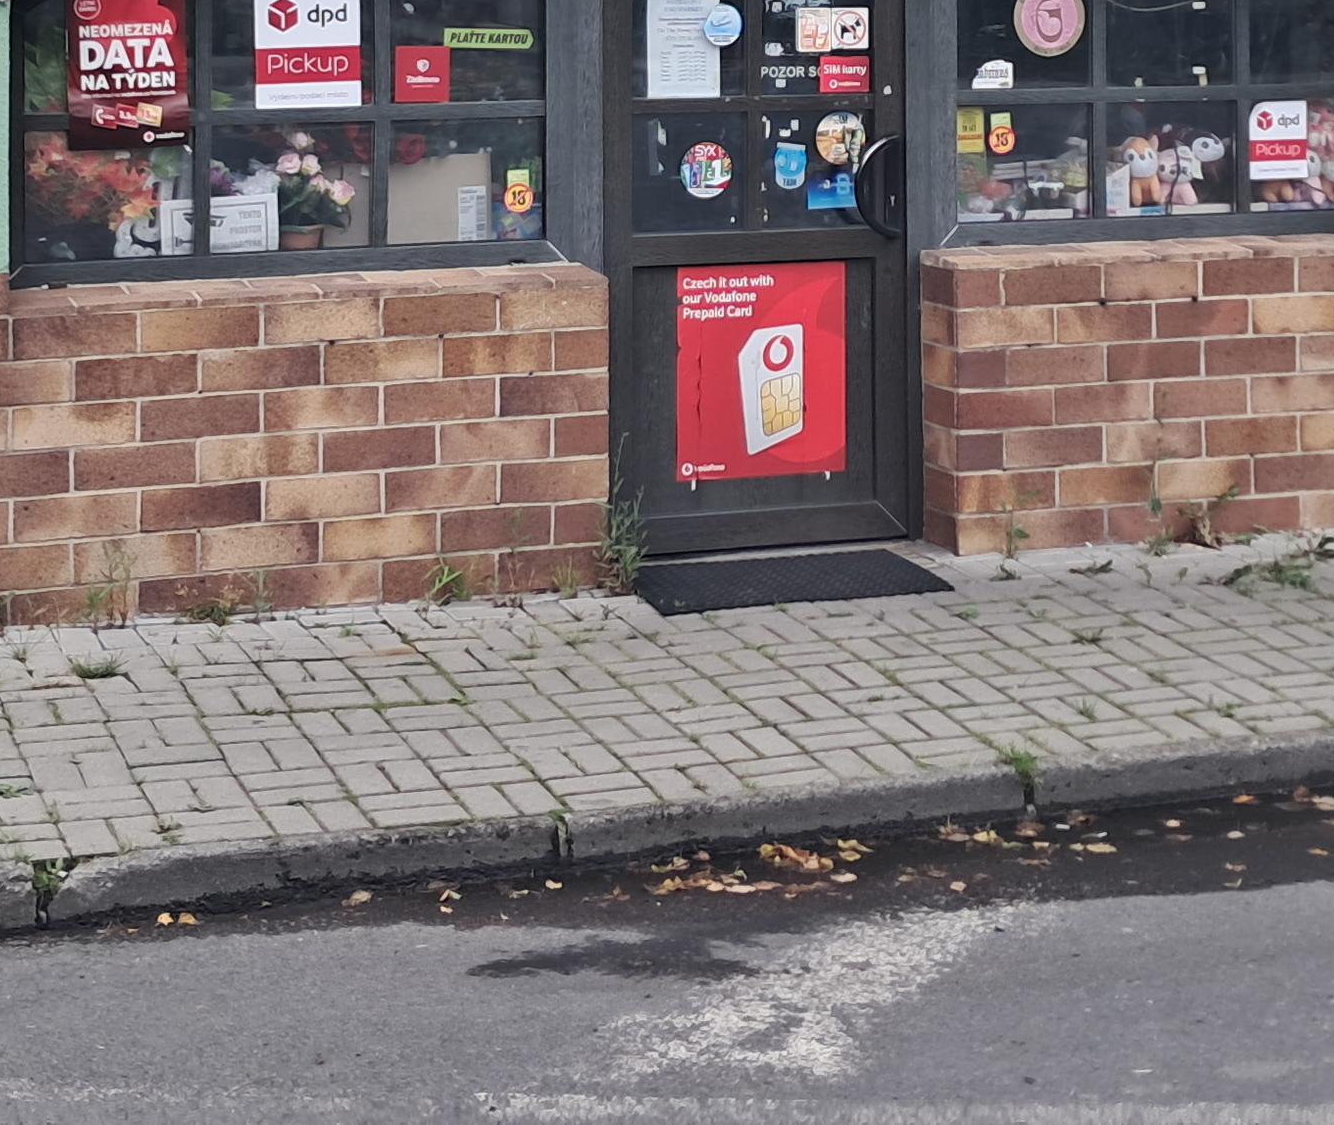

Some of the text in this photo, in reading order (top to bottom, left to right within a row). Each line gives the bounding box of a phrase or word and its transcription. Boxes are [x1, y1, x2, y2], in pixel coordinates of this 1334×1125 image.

[307, 2, 348, 28] dpd
[78, 19, 173, 38] NEOMEZENÁ
[450, 30, 528, 44] PLAŤTE KARTOU
[79, 37, 175, 71] DATA
[267, 52, 349, 77] Pickup
[760, 66, 805, 78] POZOR
[823, 64, 841, 74] SIM
[81, 69, 176, 91] NA TÝDEN
[1277, 114, 1300, 128] dpd
[1255, 142, 1301, 157] Pickup
[682, 274, 774, 290] Czech it out with
[682, 290, 757, 304] our Vodafone
[682, 304, 753, 322] Prepaid Card
